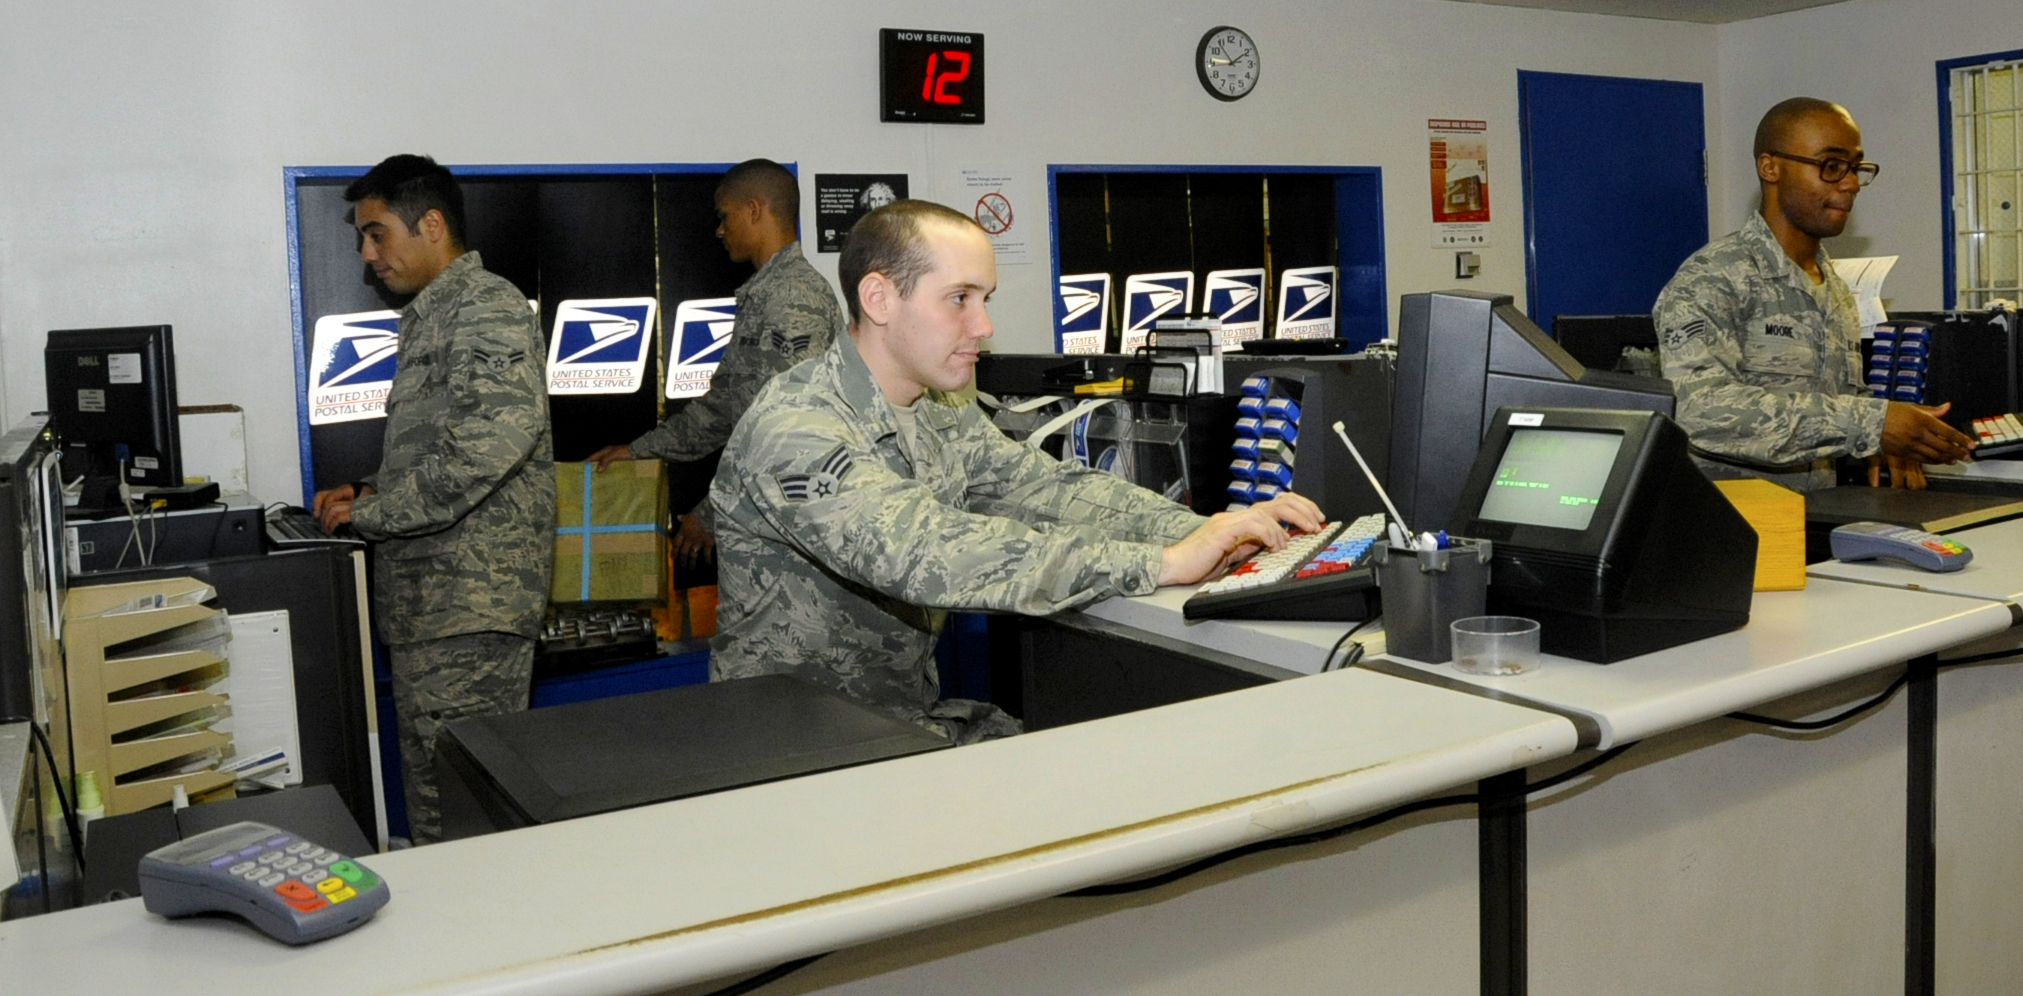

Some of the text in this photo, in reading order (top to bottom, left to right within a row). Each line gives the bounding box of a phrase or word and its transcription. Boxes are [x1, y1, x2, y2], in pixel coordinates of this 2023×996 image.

[897, 32, 971, 44] NOW SERVING
[1227, 35, 1236, 44] 12
[1211, 47, 1221, 56] 10
[1247, 60, 1254, 69] 3
[922, 51, 970, 104] 12
[1212, 70, 1219, 79] 8
[1244, 72, 1251, 80] 4
[1220, 79, 1226, 87] 7
[1229, 83, 1235, 92] 6
[1238, 80, 1244, 88] 5
[1234, 326, 1257, 336] STATES
[1280, 322, 1329, 335] UNITED STATES
[1765, 323, 1794, 338] MOORE
[1070, 336, 1097, 346] STATES
[1126, 333, 1155, 345] UNITD
[552, 367, 632, 379] UNITED STATES
[675, 369, 713, 381] UNITED
[550, 378, 635, 389] POSTAL SERVICE
[316, 388, 390, 405] UNITED STAT
[314, 404, 359, 418] POSTAL
